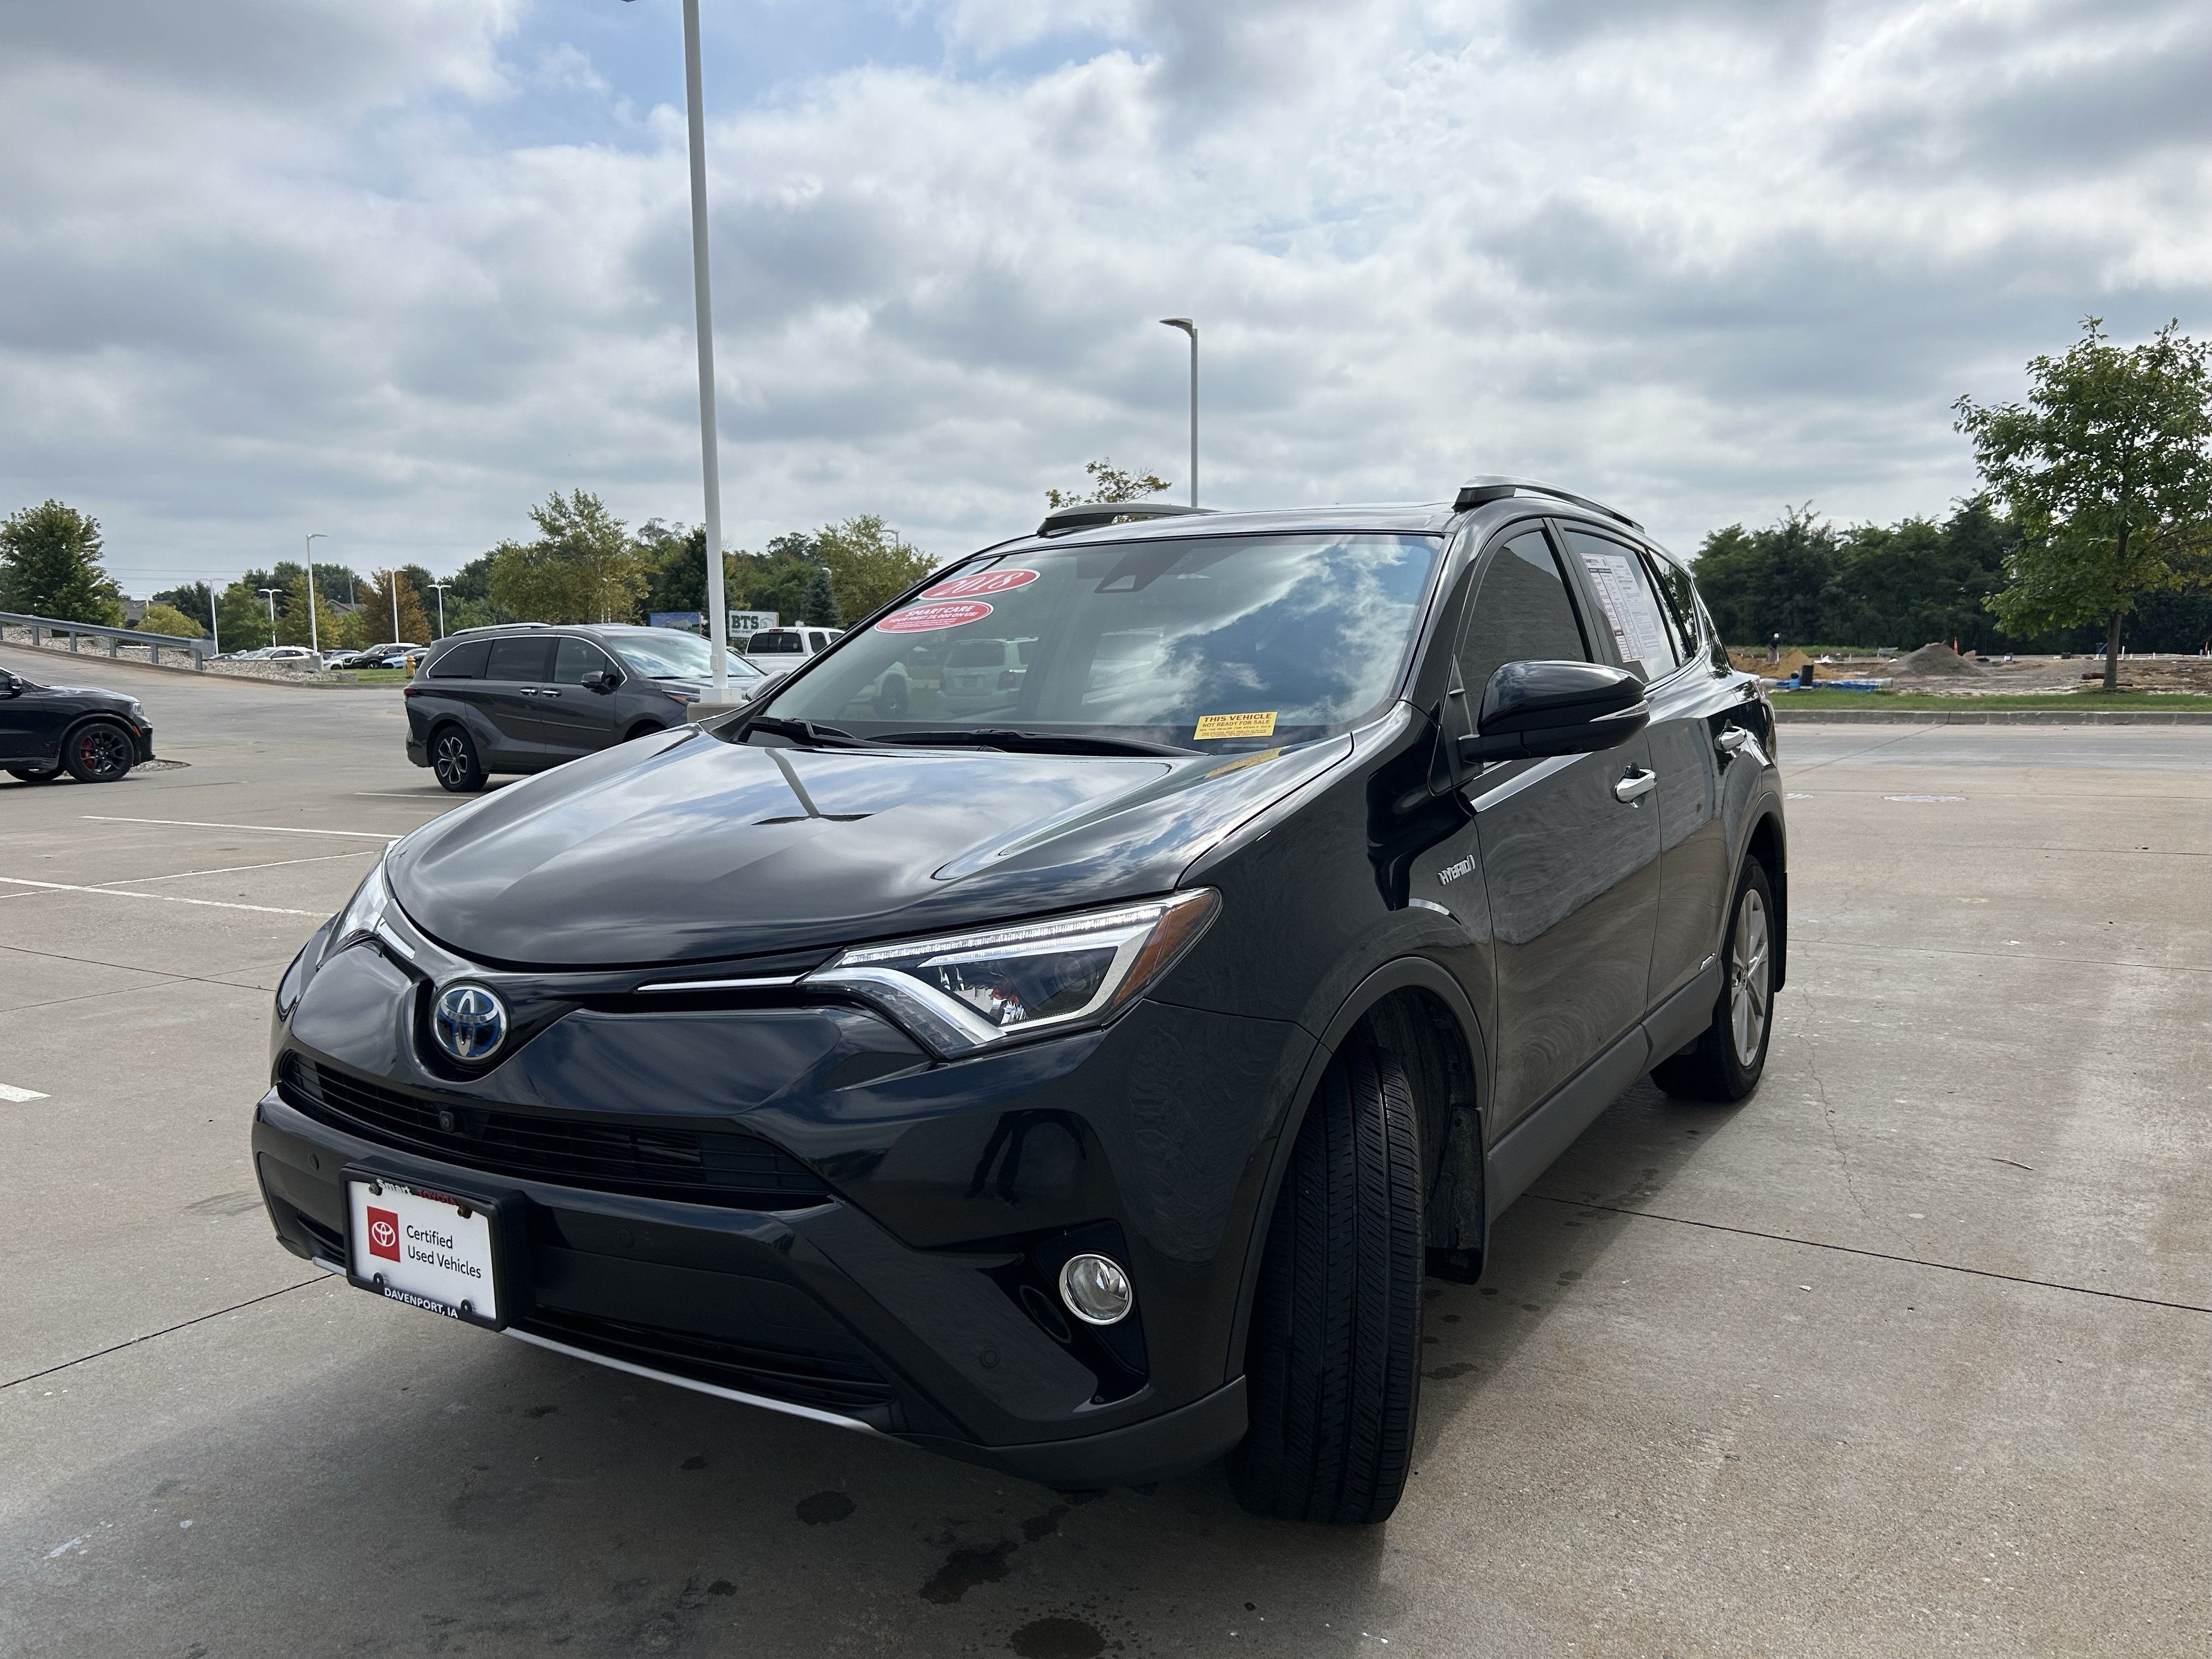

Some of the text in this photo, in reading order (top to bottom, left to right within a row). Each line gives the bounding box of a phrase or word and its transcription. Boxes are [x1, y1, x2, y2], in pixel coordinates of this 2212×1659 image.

[731, 615, 759, 629] BTS
[905, 605, 975, 618] SMART CARE
[1437, 857, 1473, 885] HYBRID
[376, 1178, 457, 1205] Smart TOYOTA
[406, 1224, 453, 1249] Certified
[408, 1245, 482, 1279] Used Vehicles
[384, 1287, 458, 1318] DAVENPORT, IA
